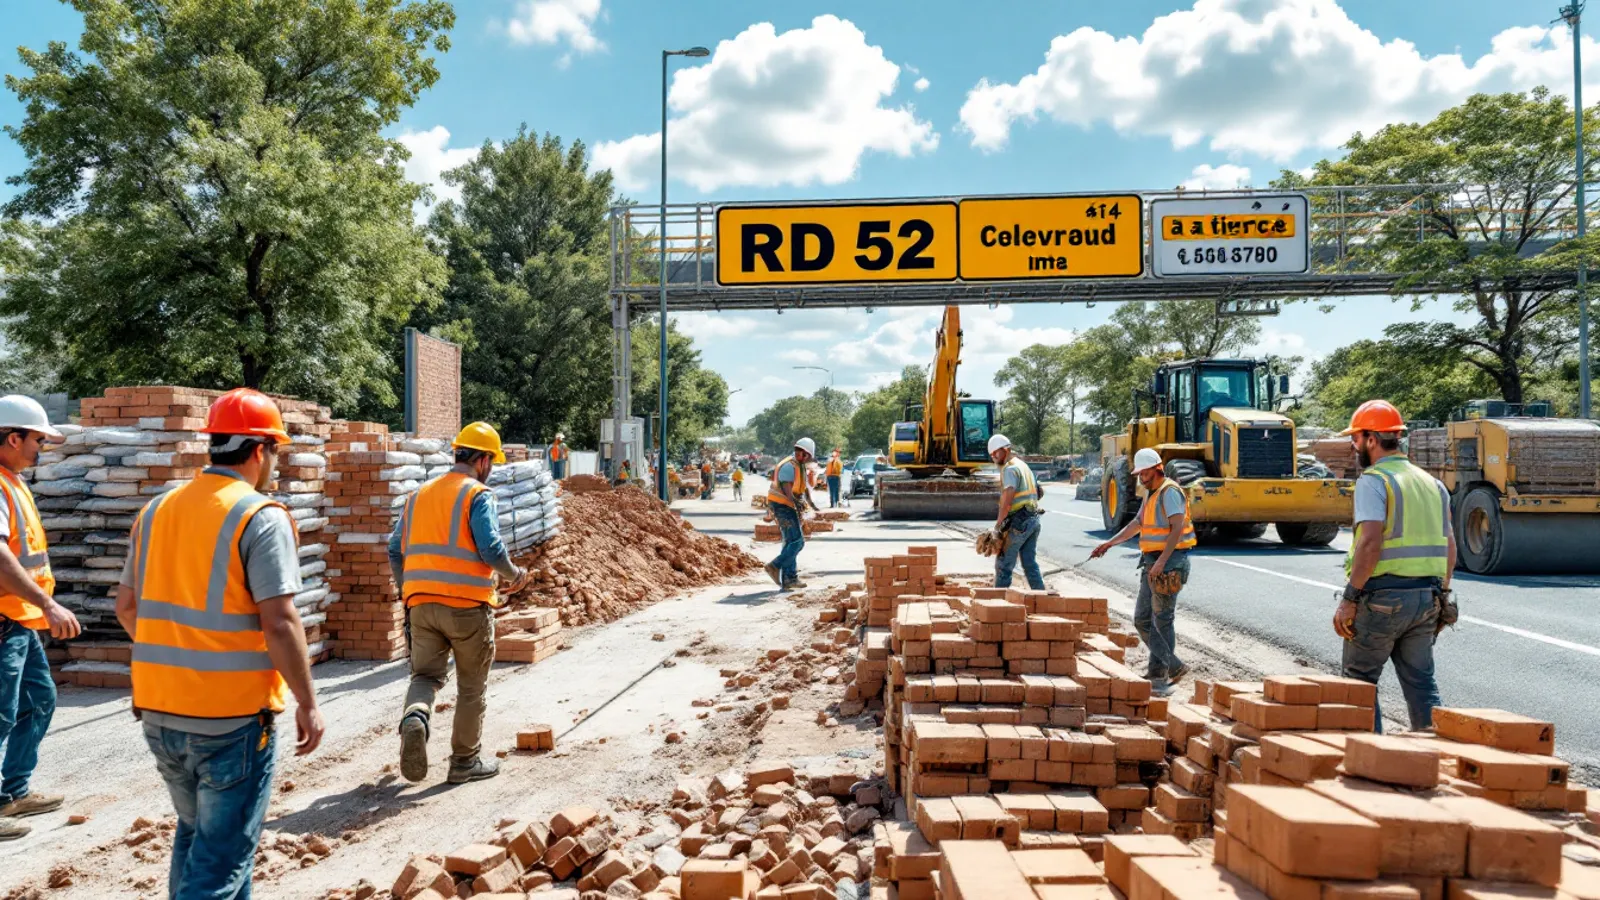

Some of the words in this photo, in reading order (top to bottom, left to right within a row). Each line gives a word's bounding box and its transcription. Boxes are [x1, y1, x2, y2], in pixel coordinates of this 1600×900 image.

[741, 223, 835, 272] RD
[854, 219, 935, 270] 52
[980, 223, 1116, 247] Celevraud
